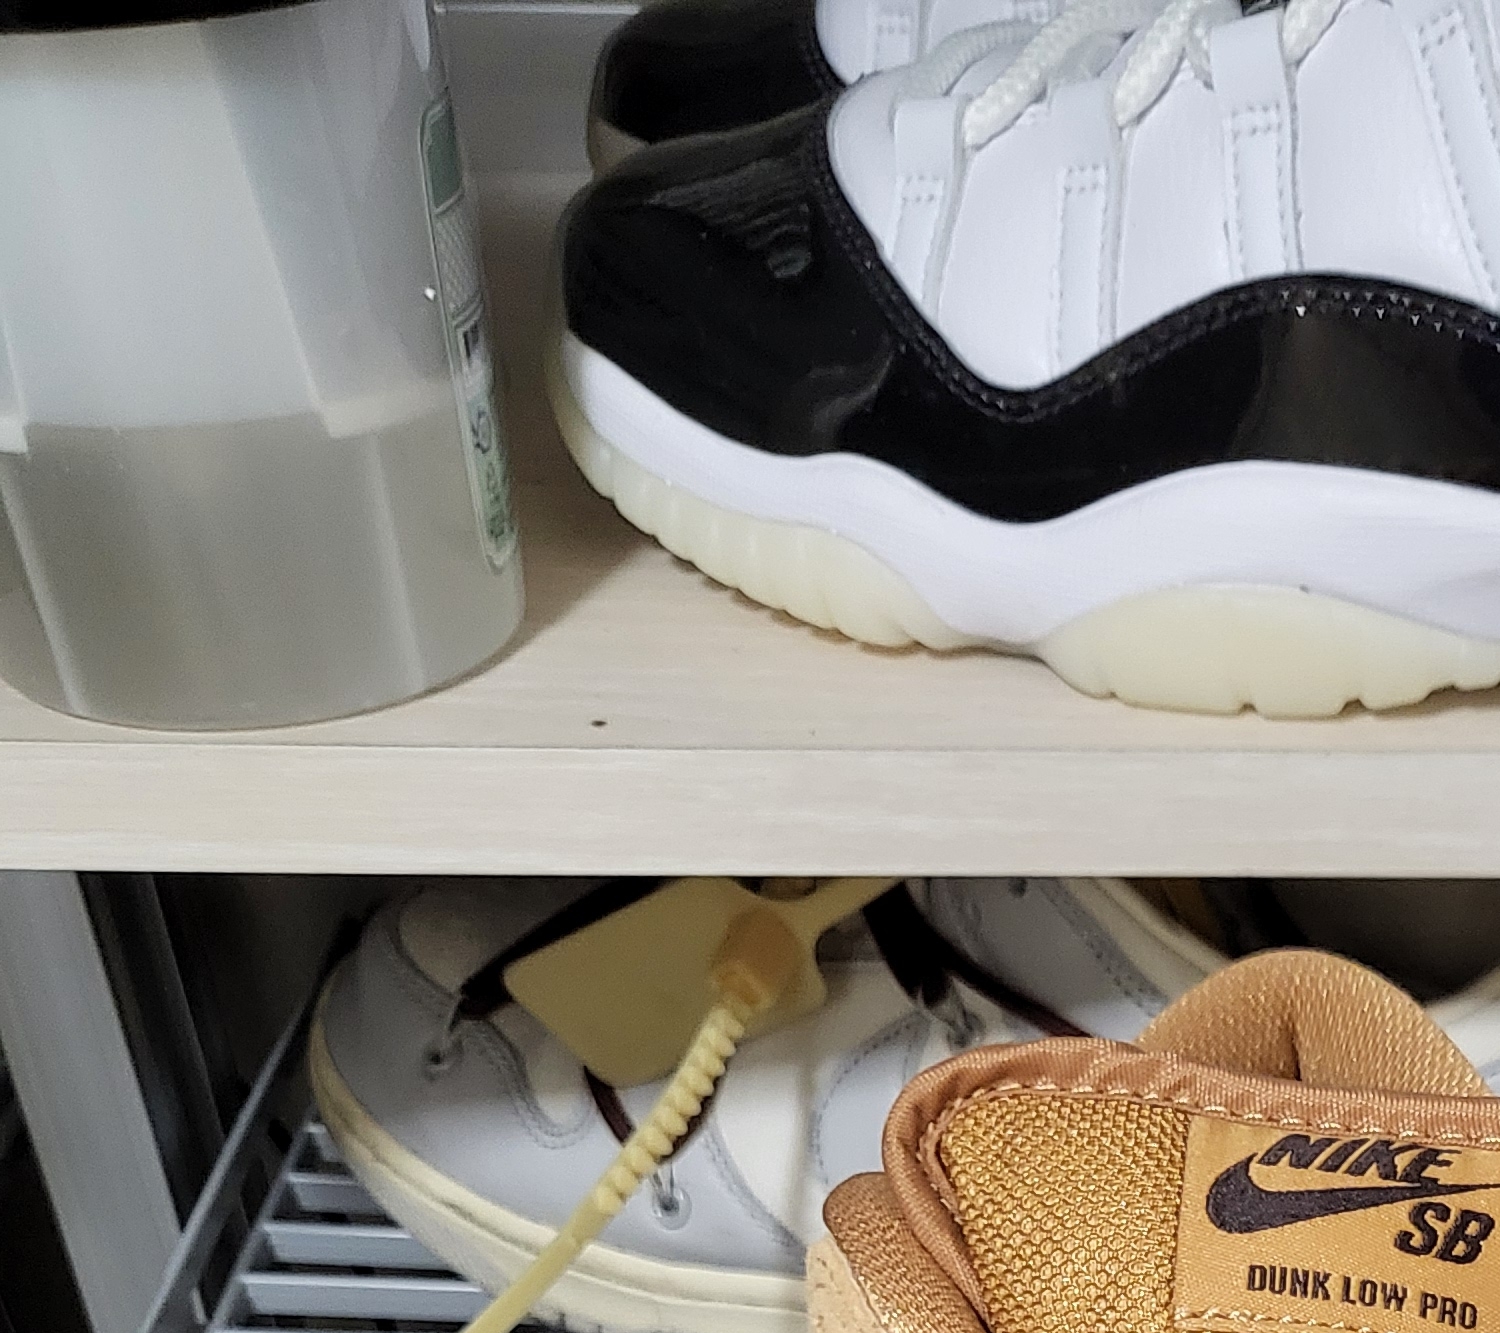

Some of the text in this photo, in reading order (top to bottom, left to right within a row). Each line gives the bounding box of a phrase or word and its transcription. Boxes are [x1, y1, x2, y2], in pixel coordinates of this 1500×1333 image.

[1257, 1133, 1463, 1185] NIKE
[1394, 1200, 1497, 1265] SB
[1246, 1264, 1479, 1331] DUNK LOW PRO
